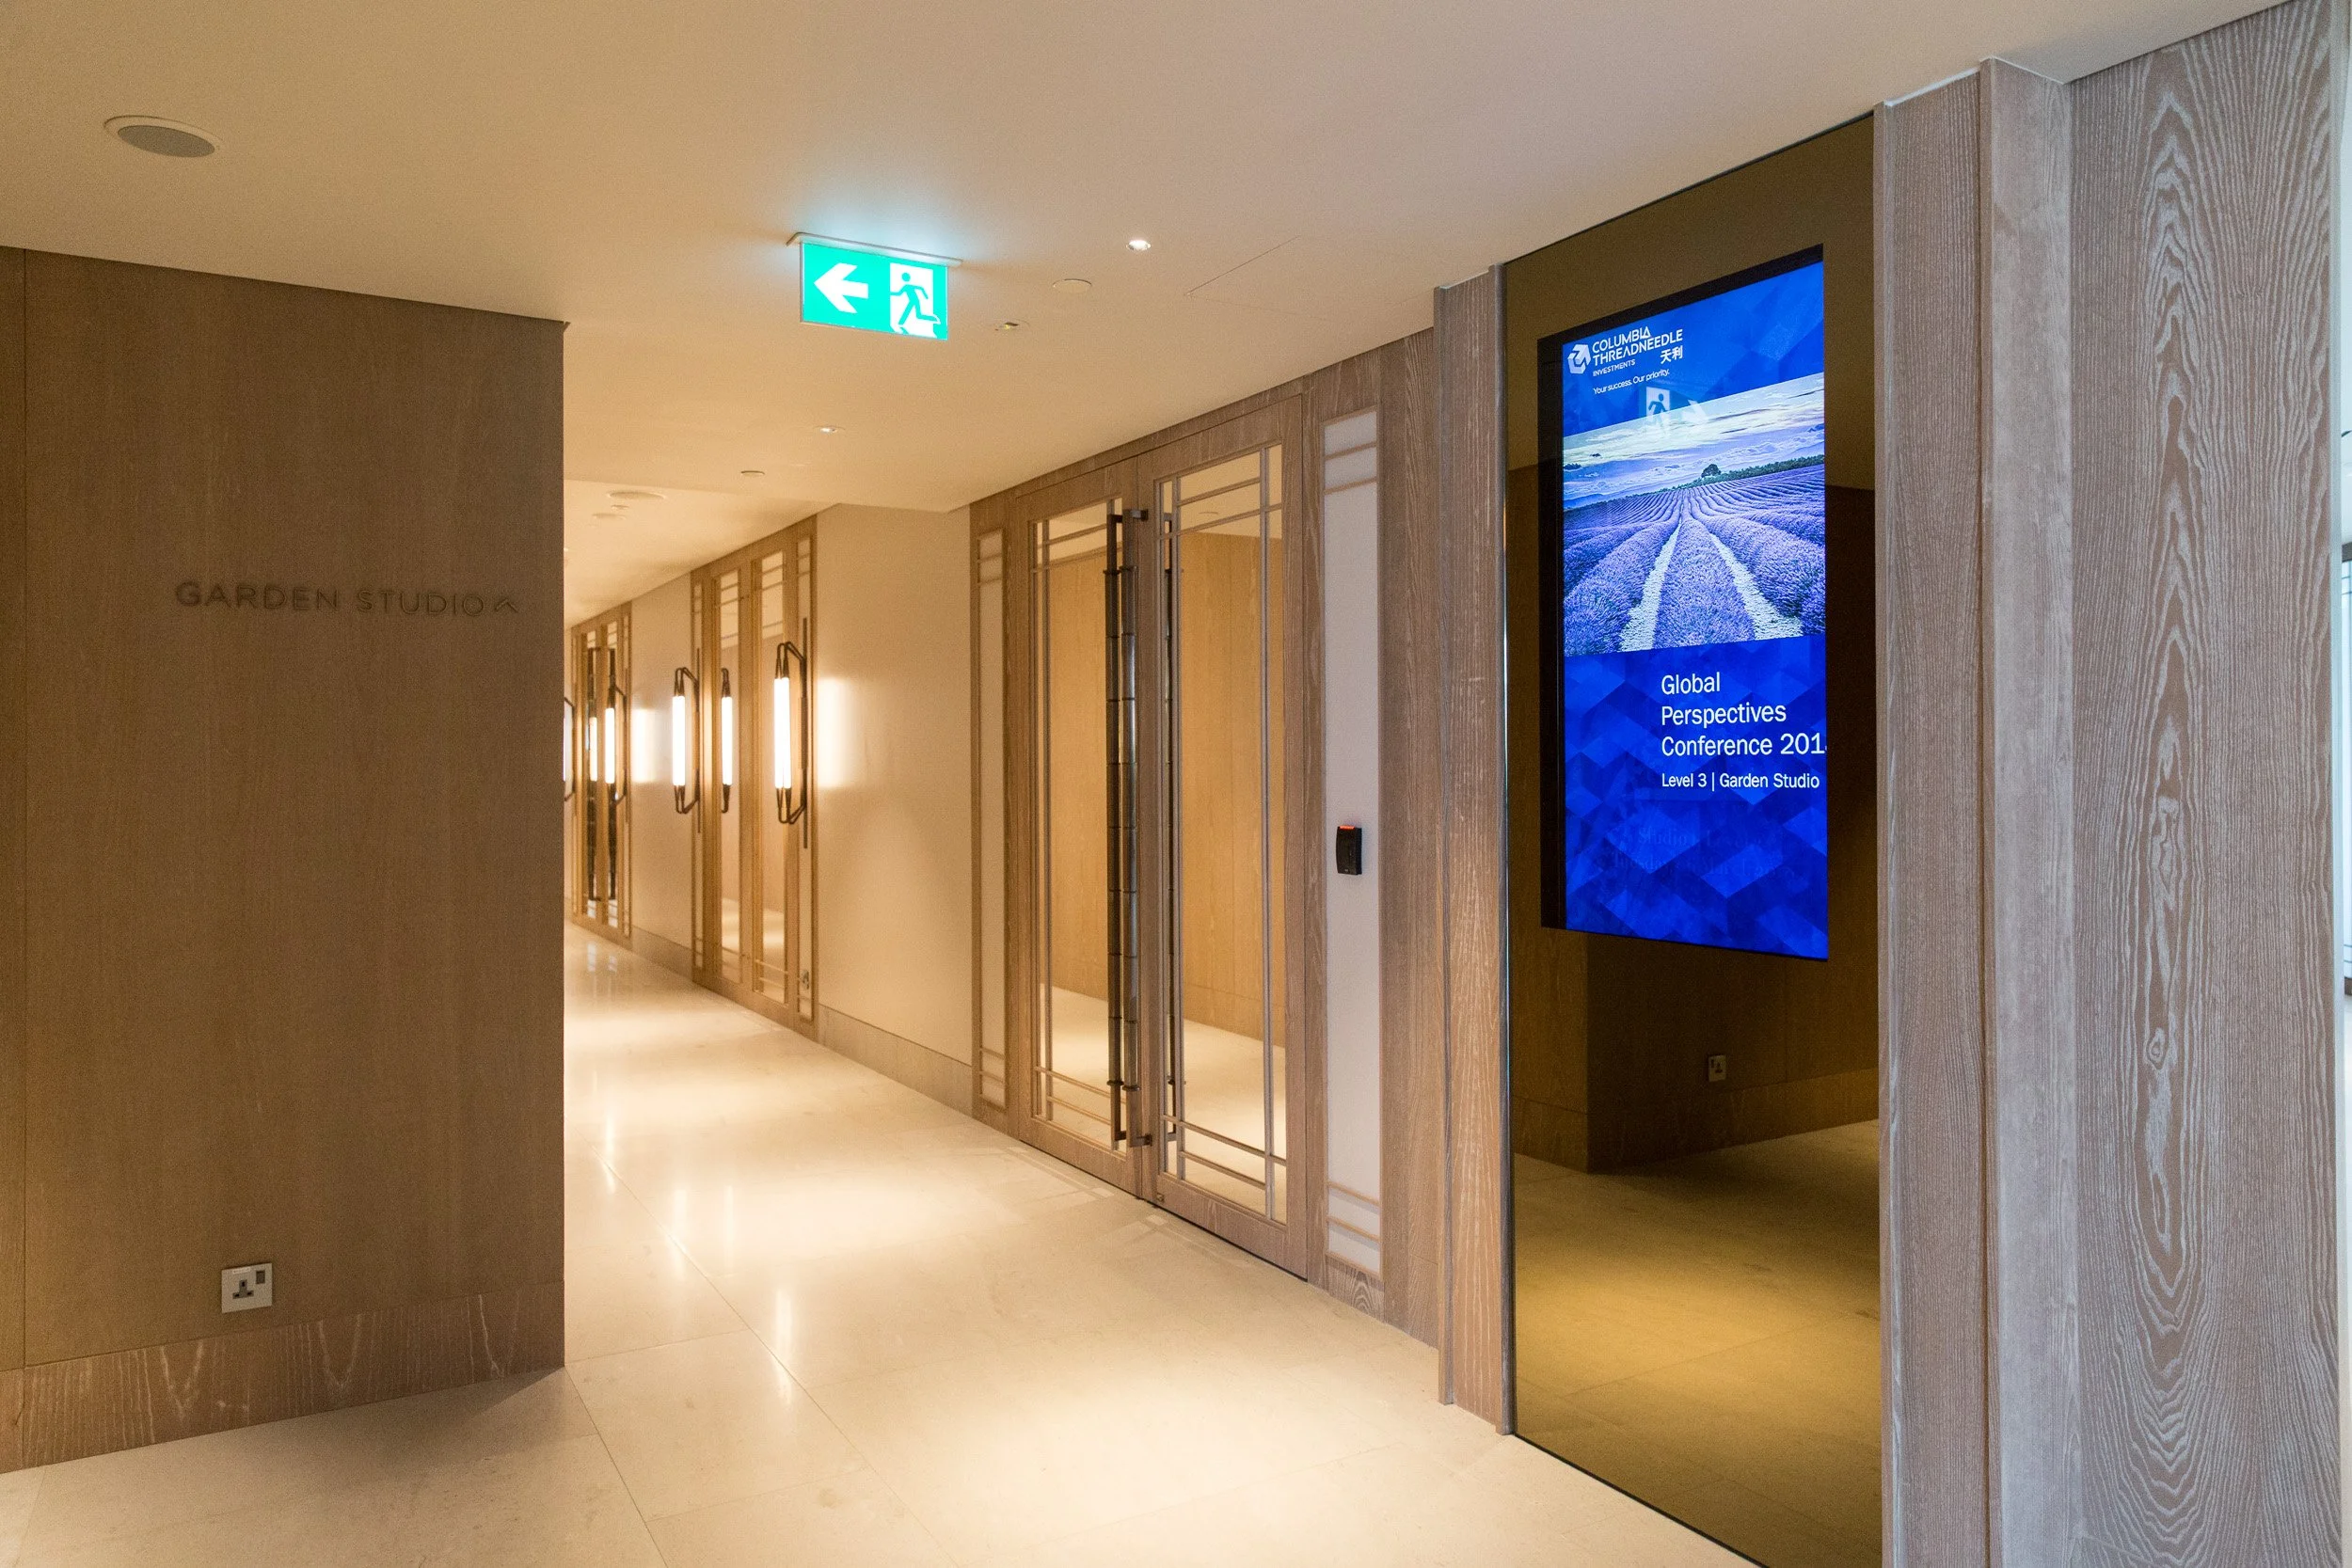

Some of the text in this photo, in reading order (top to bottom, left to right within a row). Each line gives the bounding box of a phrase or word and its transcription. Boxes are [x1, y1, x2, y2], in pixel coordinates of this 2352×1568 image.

[1592, 326, 1651, 353] COLUMBIA
[1593, 329, 1683, 366] THREADNEEDLE
[1660, 345, 1683, 365] 天利
[1593, 359, 1635, 376] INVESTMENTS
[1594, 387, 1608, 395] Your
[1608, 379, 1632, 391] success.
[1633, 374, 1645, 384] Our
[175, 580, 485, 617] GARDEN STUDIO
[1661, 672, 1721, 695] Global
[1661, 702, 1787, 729] Perspectives
[1661, 733, 1828, 756] Conference 201
[1661, 773, 1693, 787] Level
[1697, 773, 1707, 787] 3
[1720, 773, 1769, 788] Garden
[1773, 772, 1820, 788] Studio
